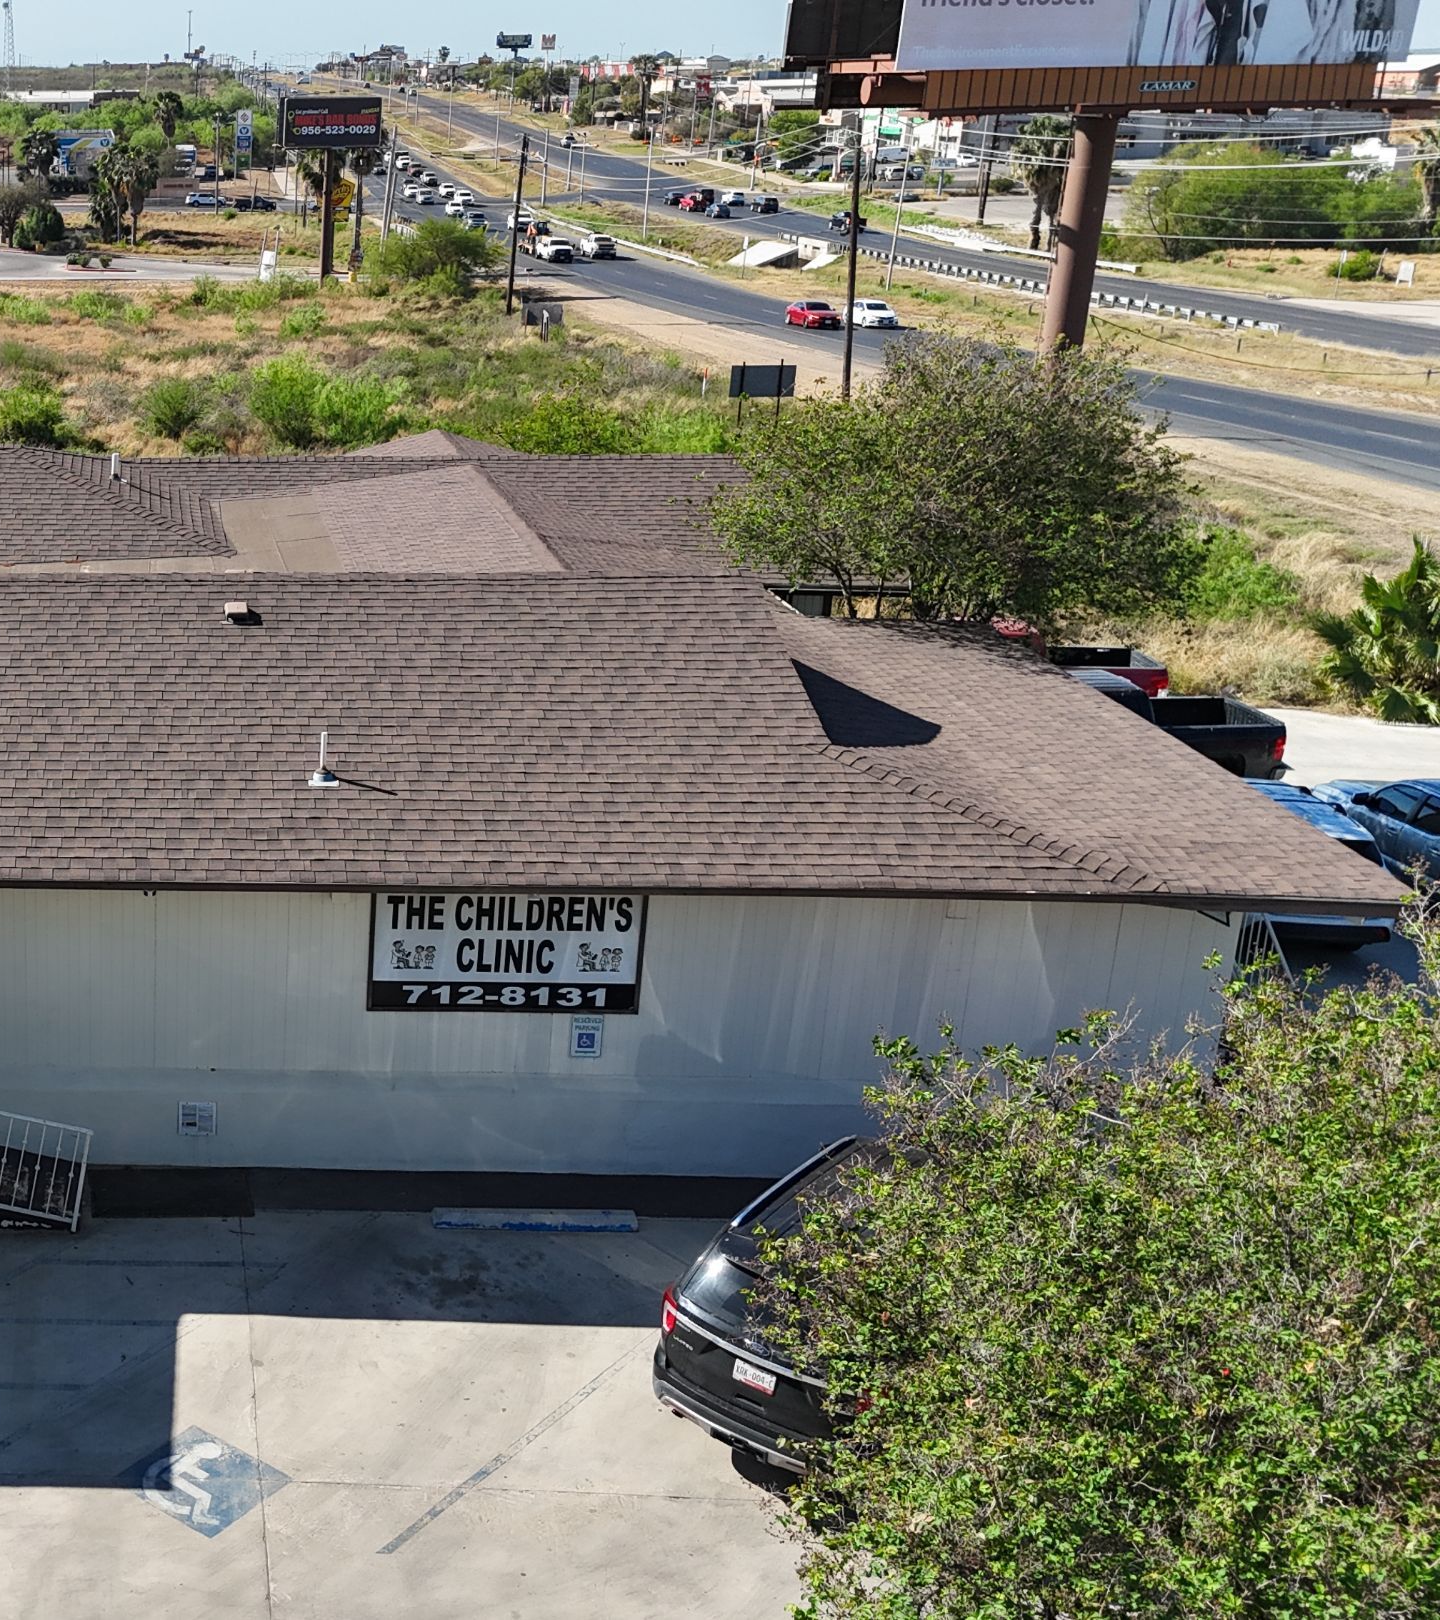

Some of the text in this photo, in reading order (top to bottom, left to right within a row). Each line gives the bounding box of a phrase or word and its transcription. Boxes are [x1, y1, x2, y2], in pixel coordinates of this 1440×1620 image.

[1143, 81, 1192, 91] LAMAR
[301, 125, 376, 135] 956-523-0029
[387, 895, 633, 932] THE CHILDREN'S
[456, 938, 555, 974] CLINIC
[402, 985, 606, 1007] 712-8131
